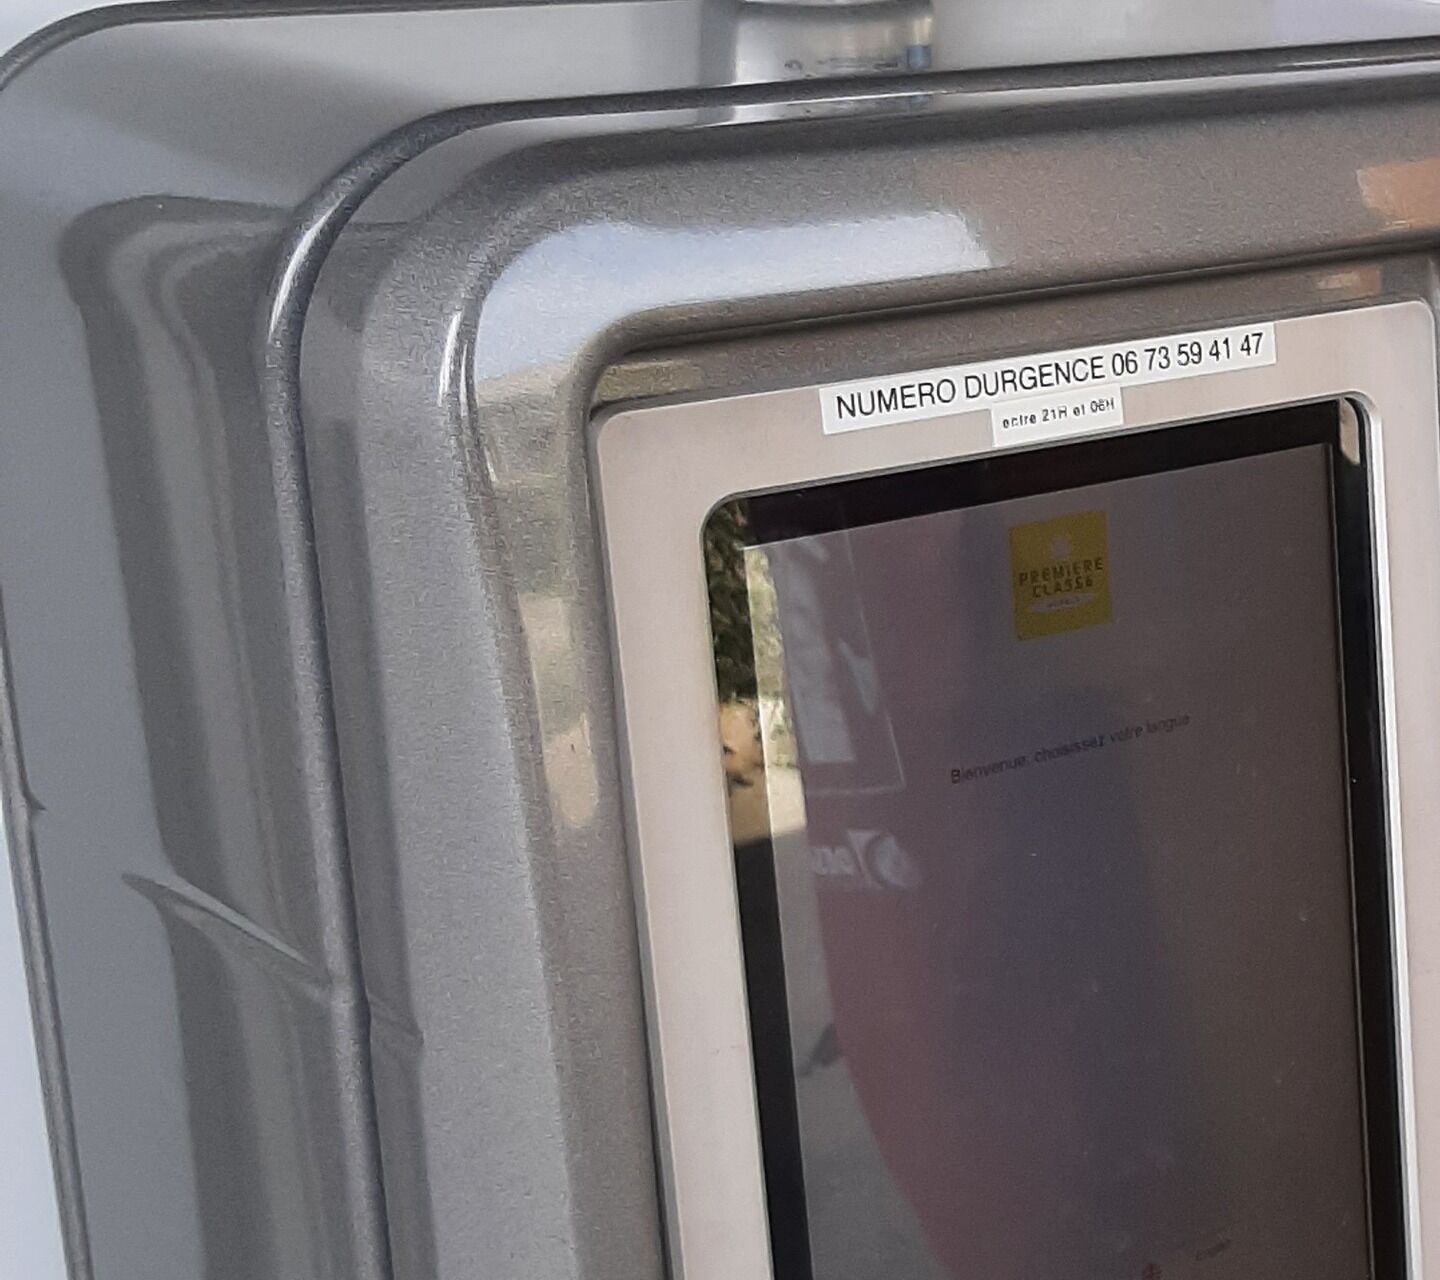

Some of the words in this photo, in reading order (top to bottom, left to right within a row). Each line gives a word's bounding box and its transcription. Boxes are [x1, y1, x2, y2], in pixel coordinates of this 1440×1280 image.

[836, 378, 956, 420] NUMERO
[964, 355, 1106, 399] DURGENCE
[1111, 351, 1138, 377] 06
[1144, 346, 1171, 371] 73
[1177, 341, 1202, 367] 59
[1209, 337, 1231, 362] 41
[1240, 332, 1263, 357] 47
[1018, 557, 1104, 587] PREMIERE
[1033, 576, 1094, 599] CLASSE
